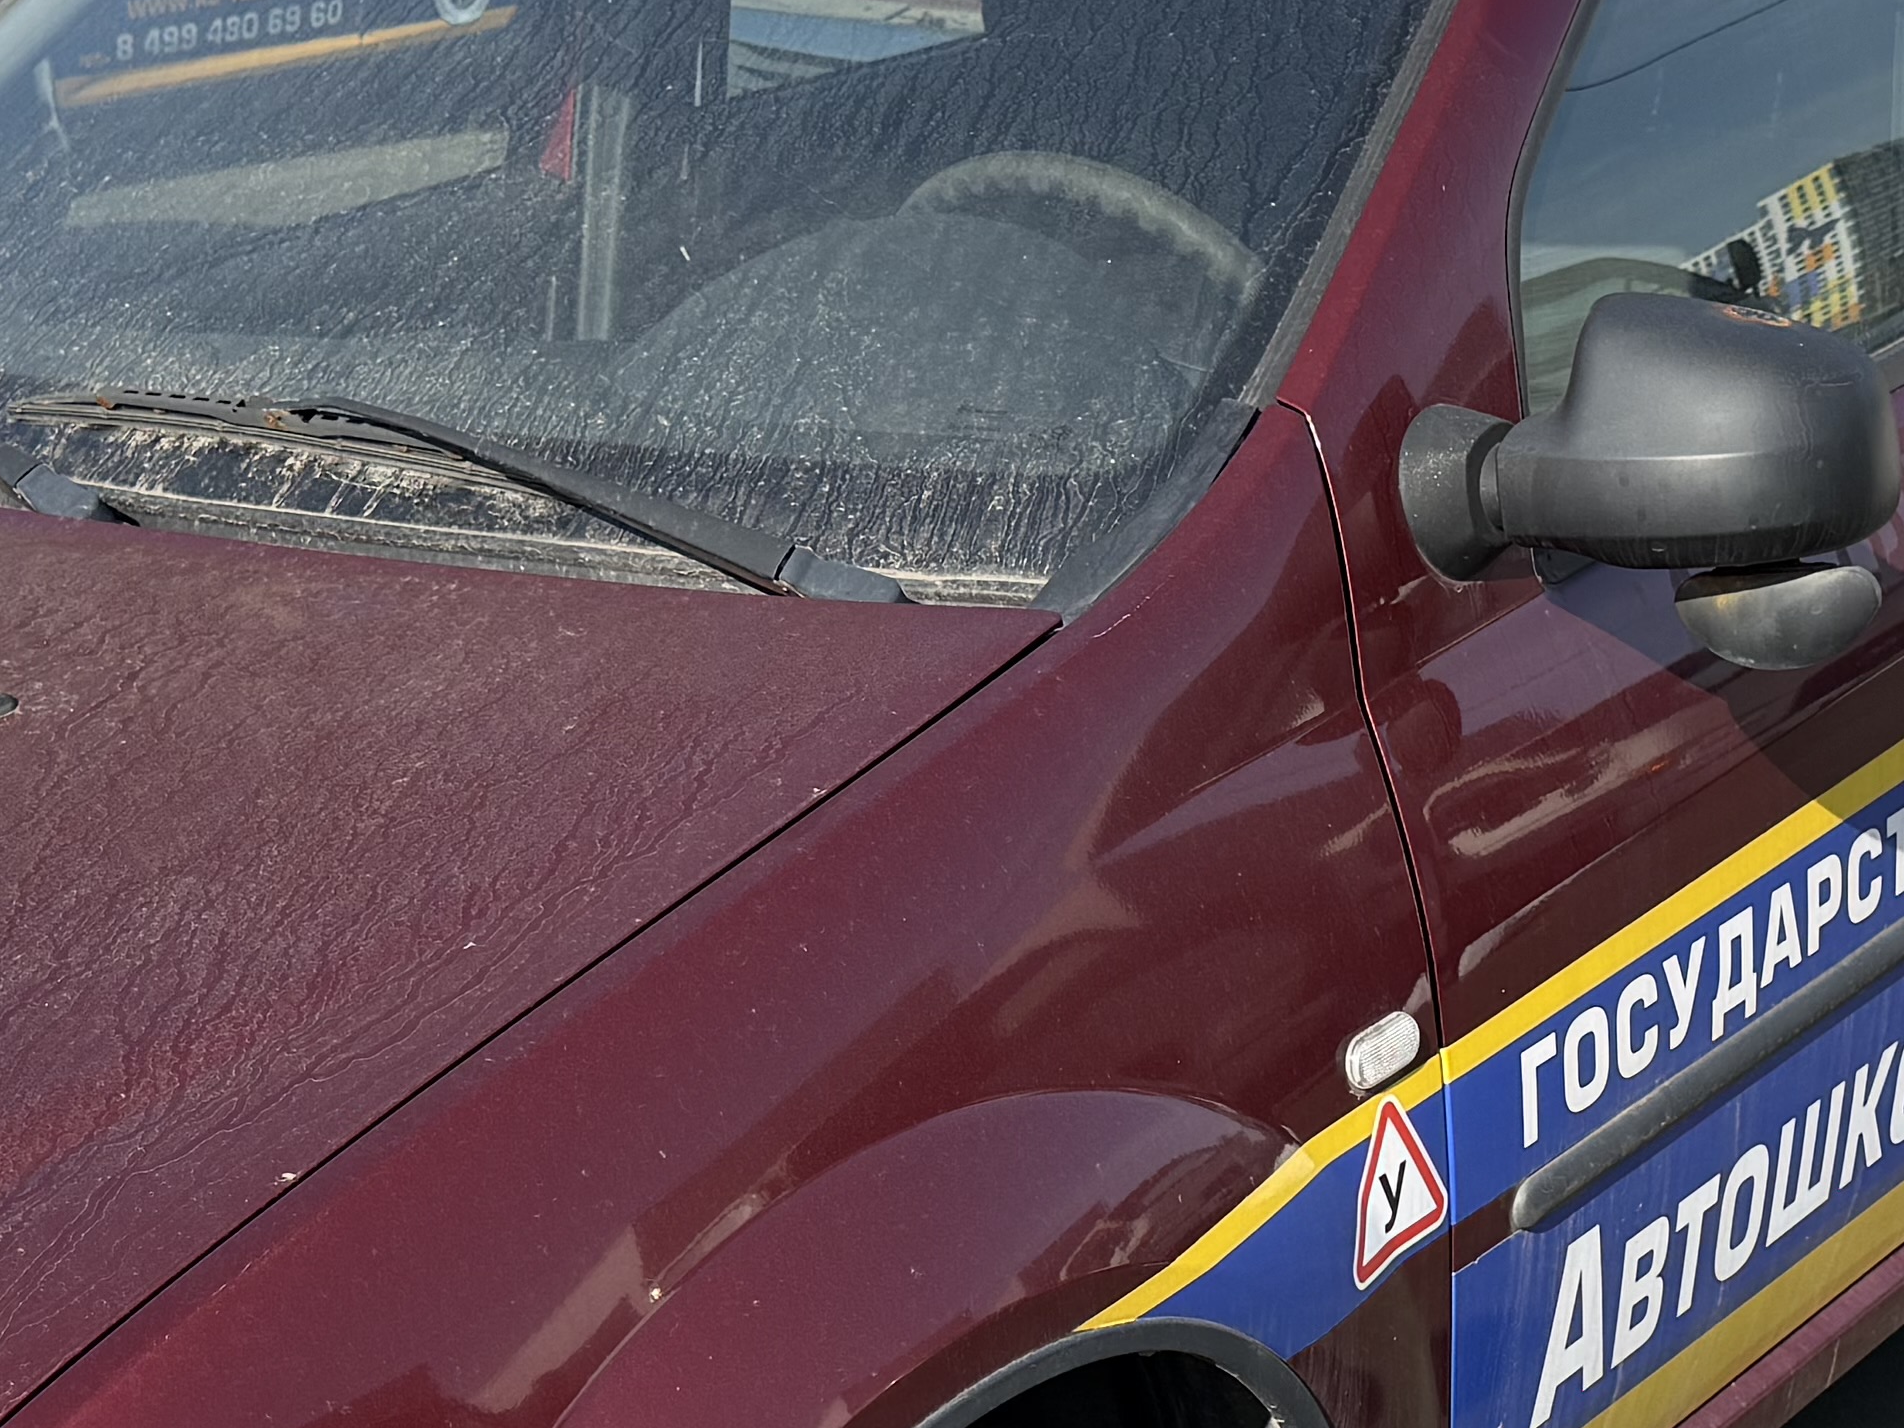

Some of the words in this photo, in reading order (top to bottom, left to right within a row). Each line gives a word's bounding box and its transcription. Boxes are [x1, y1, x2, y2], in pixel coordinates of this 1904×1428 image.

[116, 33, 134, 61] 8
[145, 23, 197, 56] 499
[206, 12, 259, 45] 480
[267, 5, 301, 35] 69
[1379, 1159, 1407, 1234] У
